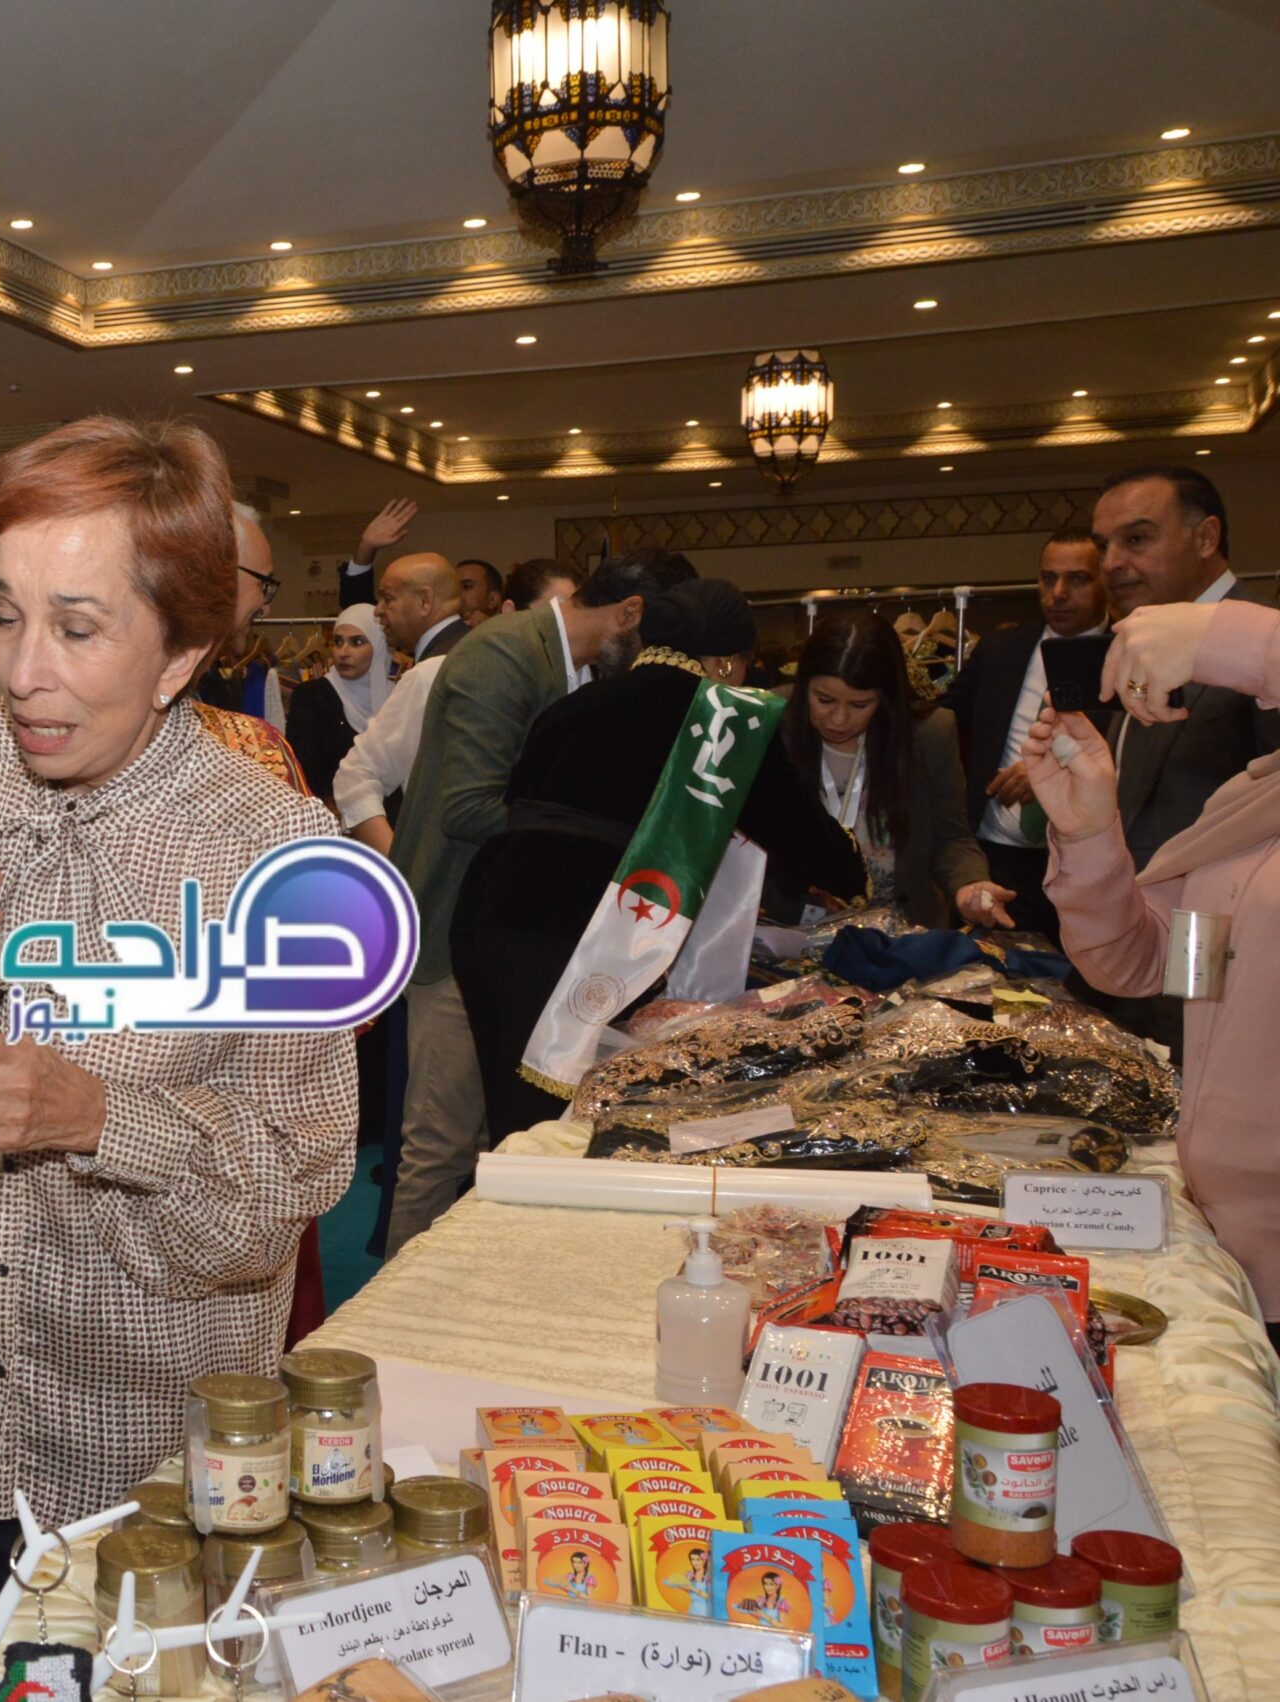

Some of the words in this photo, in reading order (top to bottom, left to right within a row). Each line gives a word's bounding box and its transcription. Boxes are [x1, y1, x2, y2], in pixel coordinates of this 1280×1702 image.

[1024, 1183, 1067, 1195] Caprice
[1066, 1220, 1105, 1231] Caramel
[1107, 1222, 1135, 1233] Candy
[860, 1249, 927, 1264] 1001
[760, 1363, 828, 1392] 1001
[321, 1437, 351, 1446] CEBON
[312, 1469, 355, 1487] Mordjene
[639, 1479, 692, 1494] Nouara
[537, 1480, 590, 1496] Nouara
[542, 1507, 597, 1523] Nouara
[647, 1503, 702, 1518] Nouara
[551, 1530, 602, 1547] نوارة
[741, 1546, 795, 1566] نوارة
[414, 1569, 471, 1605] المرجان
[320, 1600, 393, 1631] Mordjene
[437, 1633, 475, 1655] spread
[558, 1634, 608, 1659] Flan
[720, 1651, 764, 1675] فلان
[1091, 1676, 1141, 1700] الحانوت
[1146, 1673, 1176, 1694] راس
